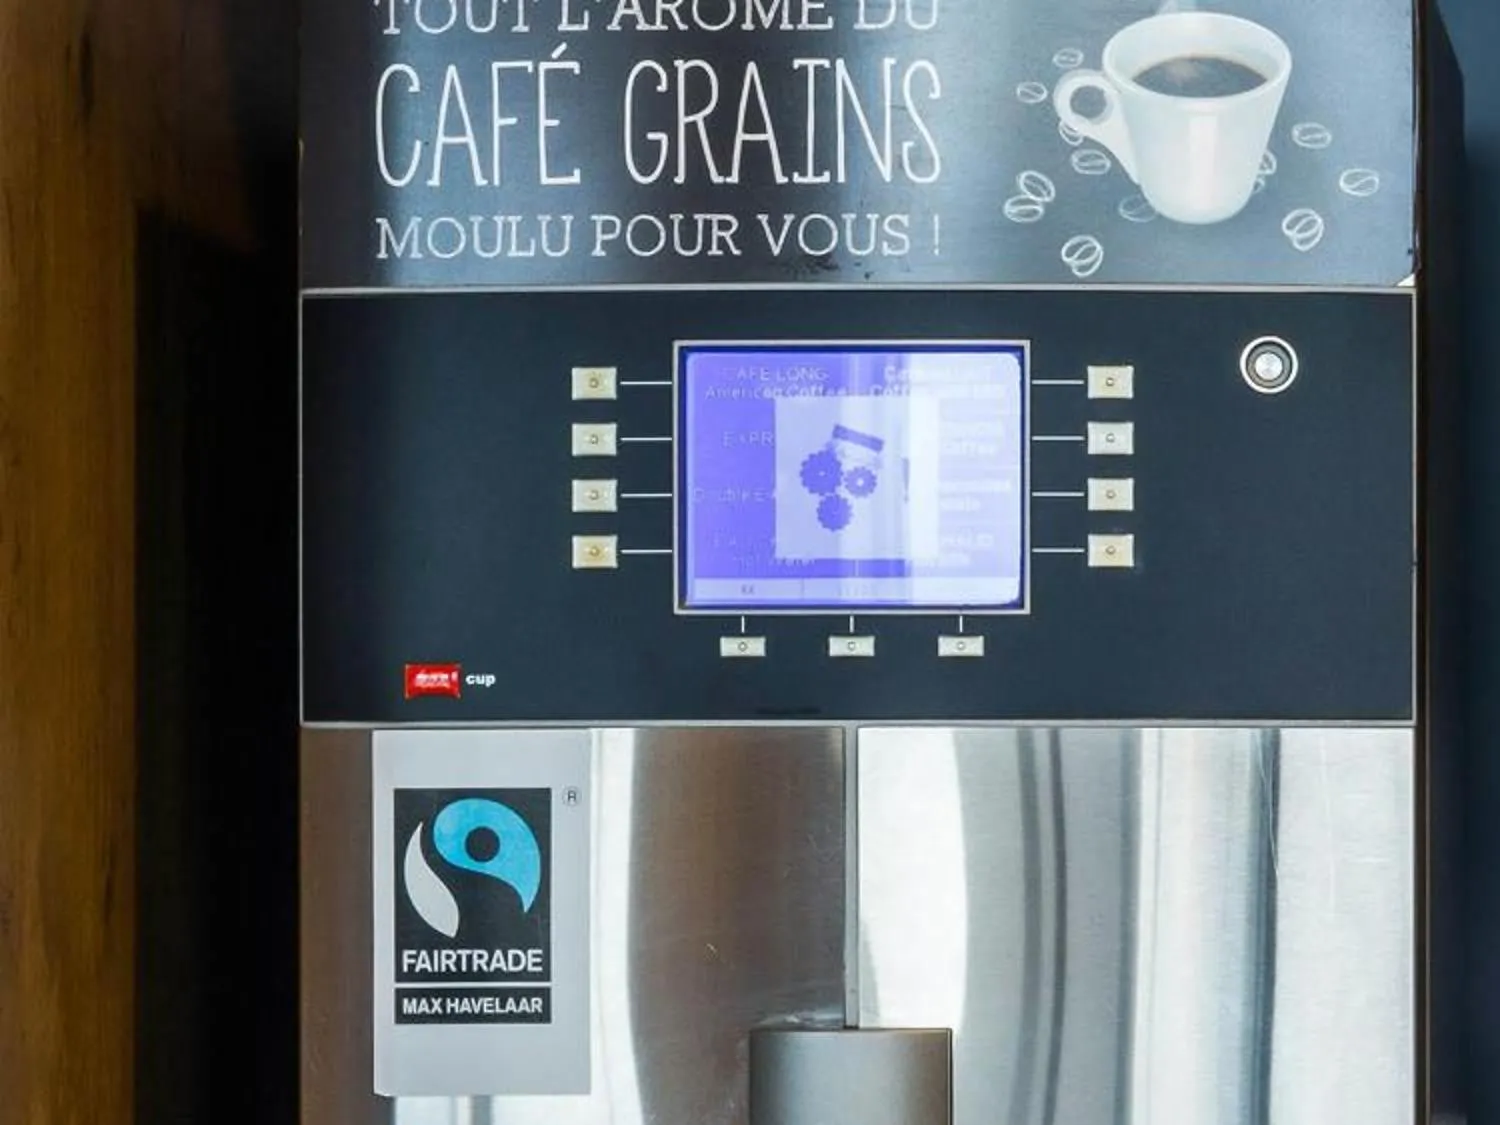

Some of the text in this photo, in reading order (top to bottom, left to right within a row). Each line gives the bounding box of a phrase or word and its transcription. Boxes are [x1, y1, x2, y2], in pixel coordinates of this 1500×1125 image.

[557, 0, 834, 31] LAROME
[853, 0, 940, 30] DU
[375, 43, 942, 187] CAFÉ GRAINS
[375, 215, 573, 260] MOULU
[590, 213, 741, 258] POUR
[757, 212, 911, 258] VOUS
[465, 673, 496, 688] cup
[402, 949, 543, 973] FAIRTRADE
[402, 997, 543, 1015] MAX HAVELAAR
